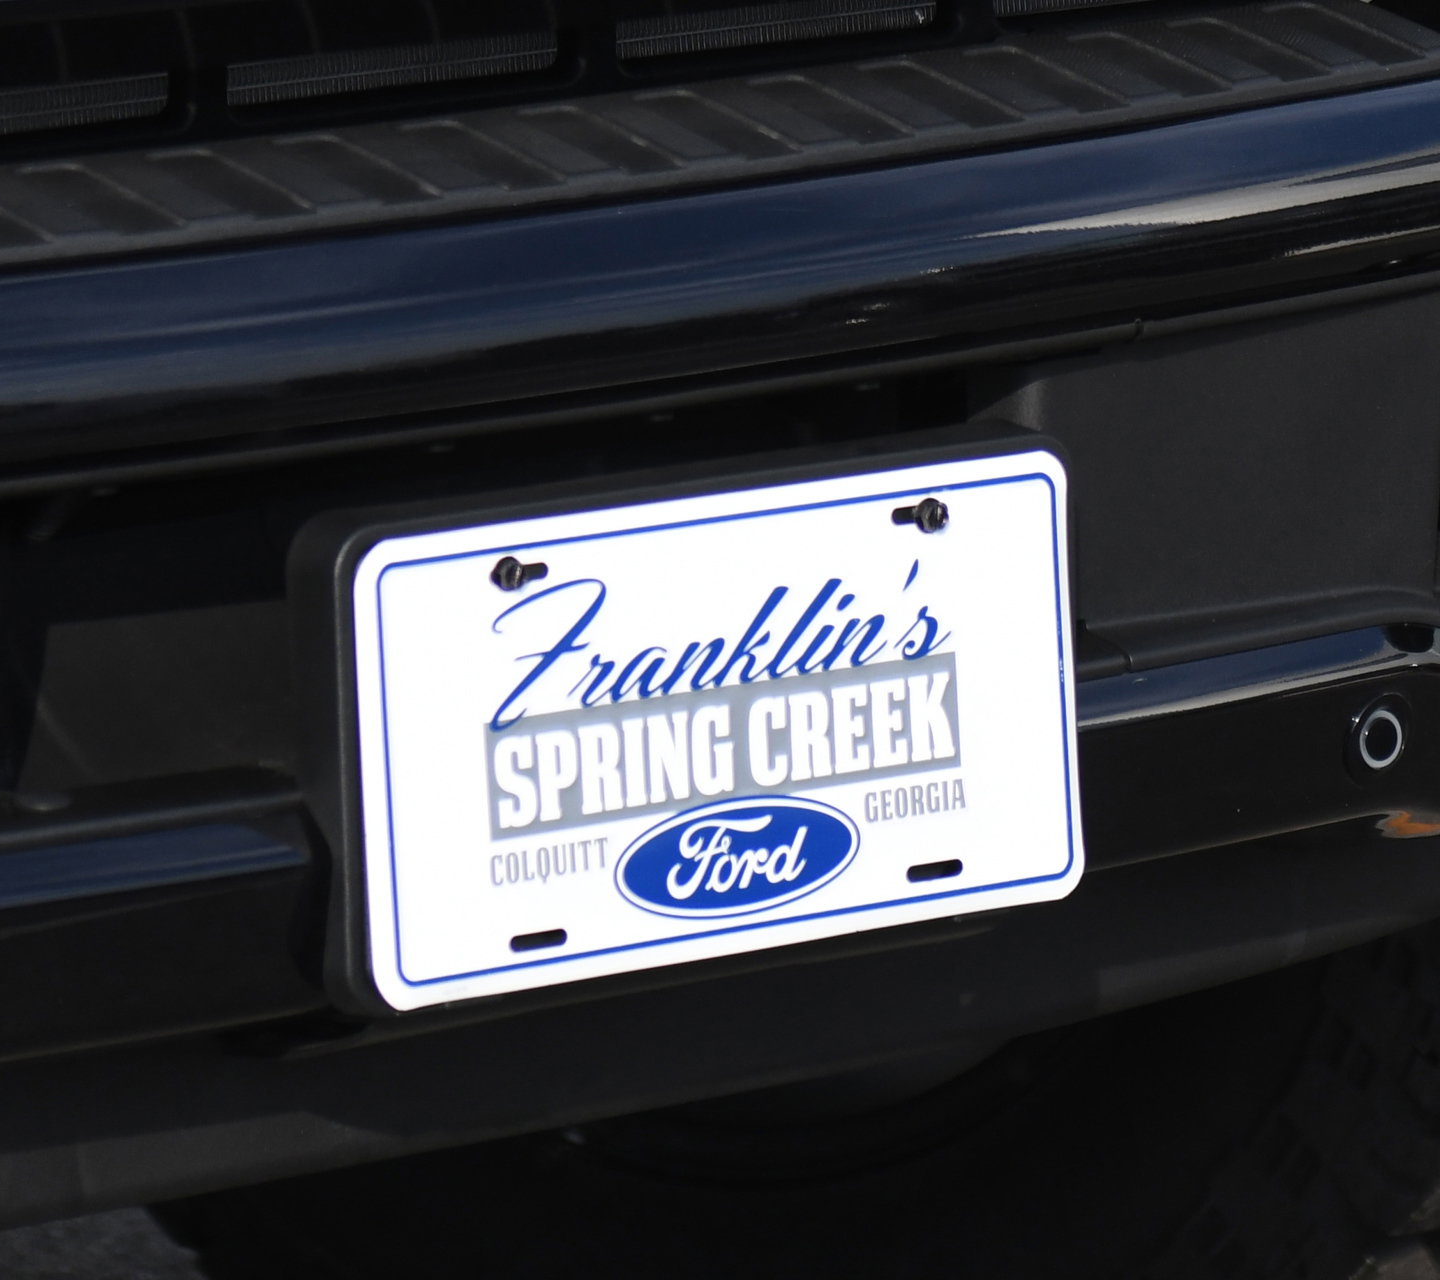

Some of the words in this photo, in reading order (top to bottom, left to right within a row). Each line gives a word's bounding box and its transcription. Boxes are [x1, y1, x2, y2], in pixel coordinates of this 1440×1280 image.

[490, 557, 953, 732] Franklin's
[493, 703, 736, 830] SPRING
[747, 670, 957, 788] CREEK
[863, 778, 968, 824] GEORGIA
[489, 836, 609, 887] COLQUITT
[666, 814, 808, 901] Ford
